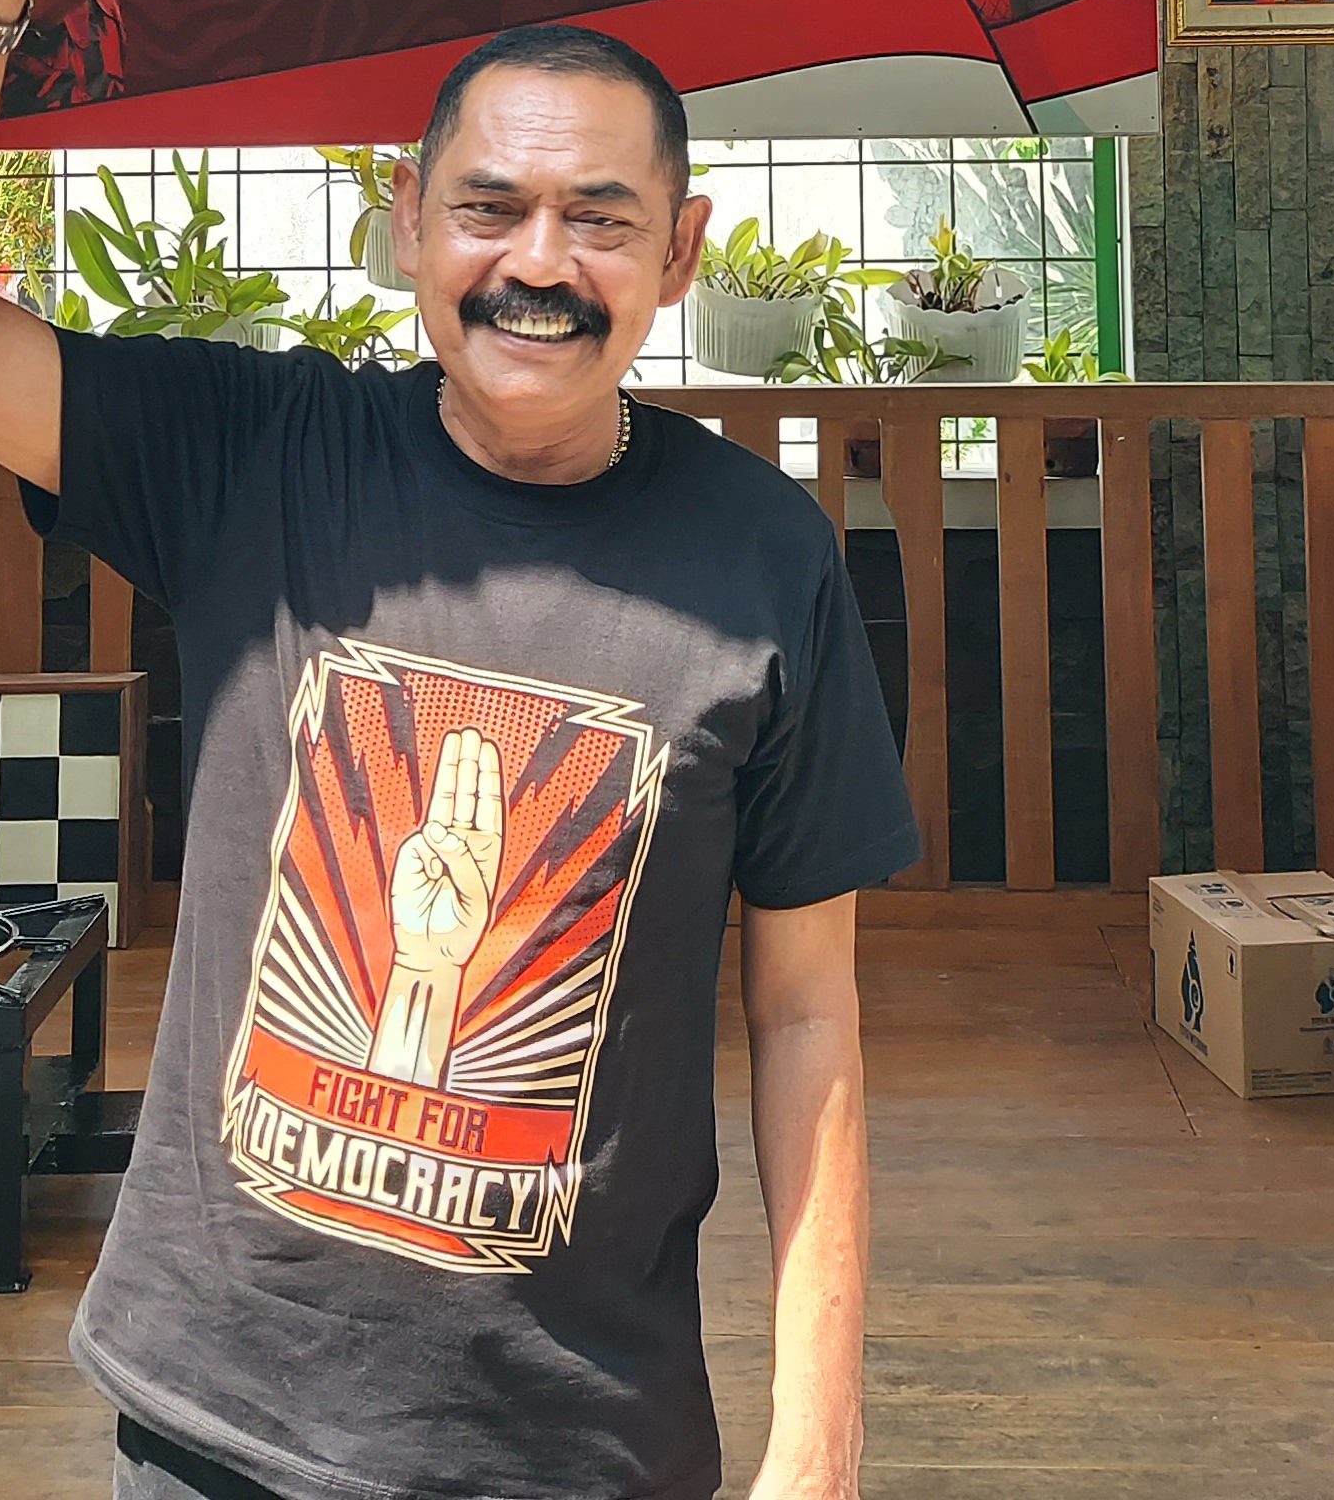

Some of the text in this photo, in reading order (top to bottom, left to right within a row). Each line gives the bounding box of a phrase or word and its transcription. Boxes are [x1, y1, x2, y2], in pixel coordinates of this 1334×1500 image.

[248, 1098, 536, 1230] DEMOCRACY
[308, 1065, 488, 1153] FIGHT FOR
